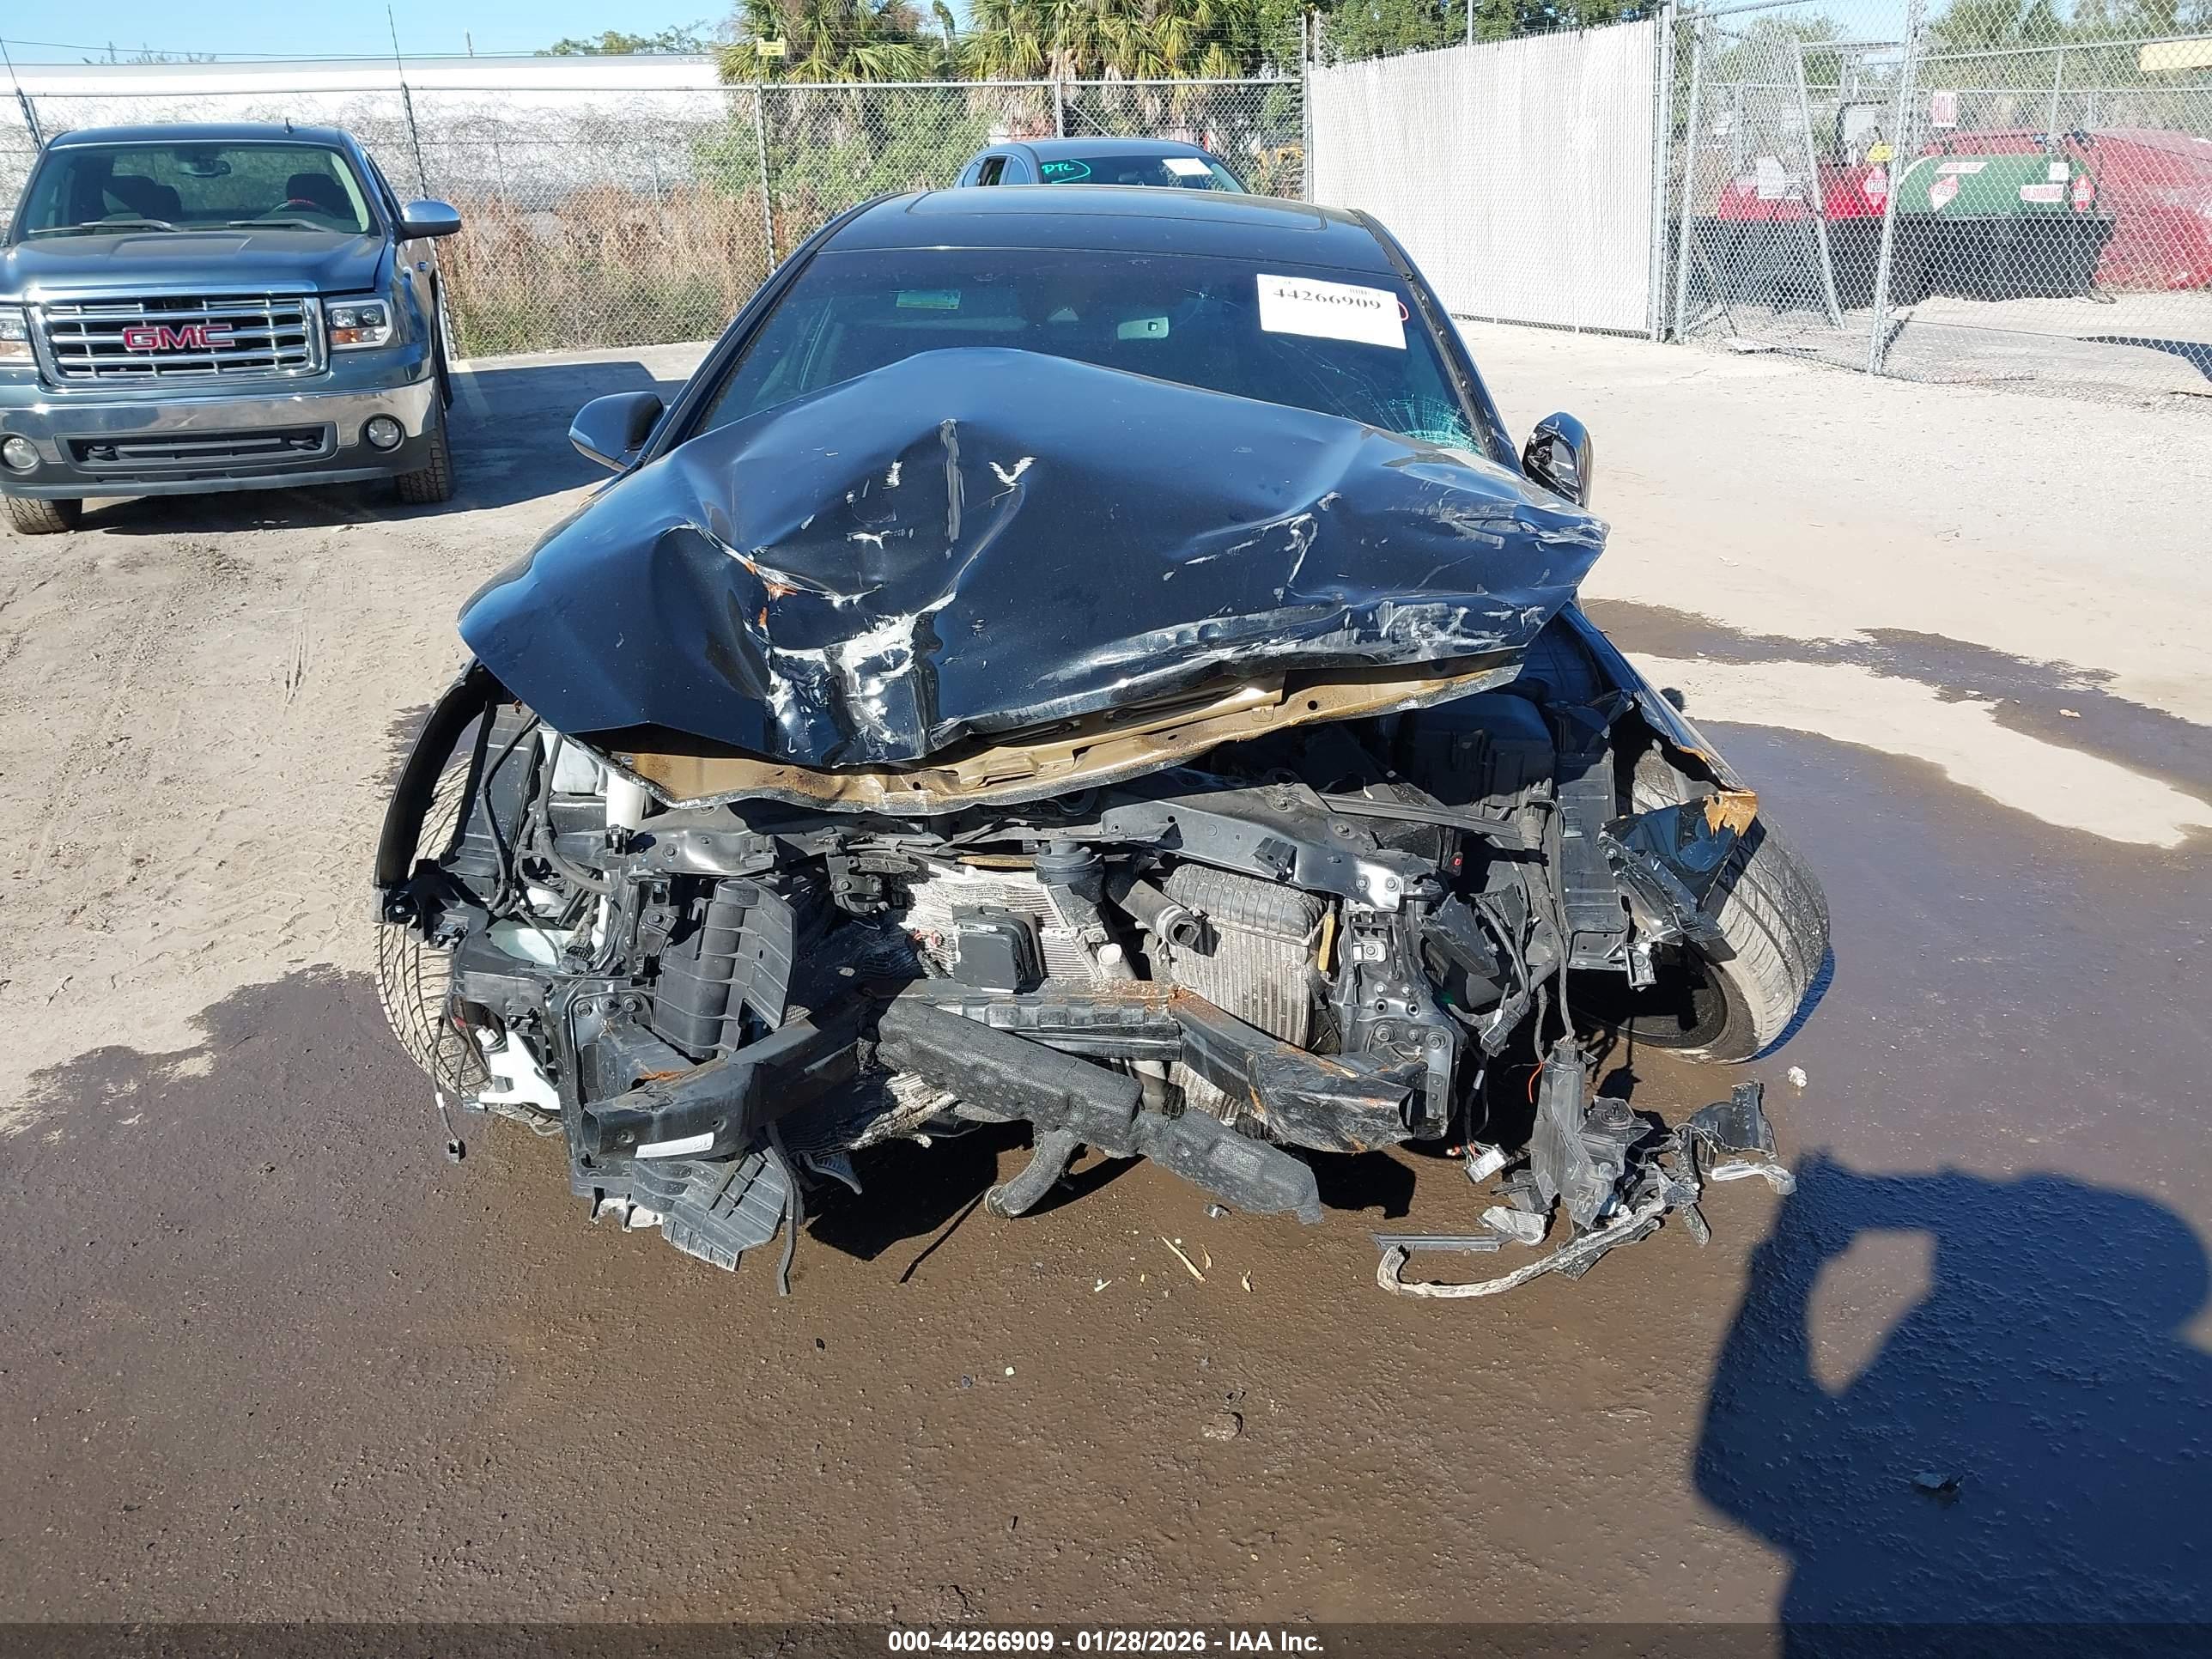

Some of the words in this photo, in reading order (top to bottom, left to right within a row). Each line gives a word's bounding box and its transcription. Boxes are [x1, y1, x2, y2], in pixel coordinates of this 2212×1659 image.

[1869, 180, 1885, 191] 1203
[1273, 288, 1382, 310] 44266909
[122, 323, 236, 352] GMC
